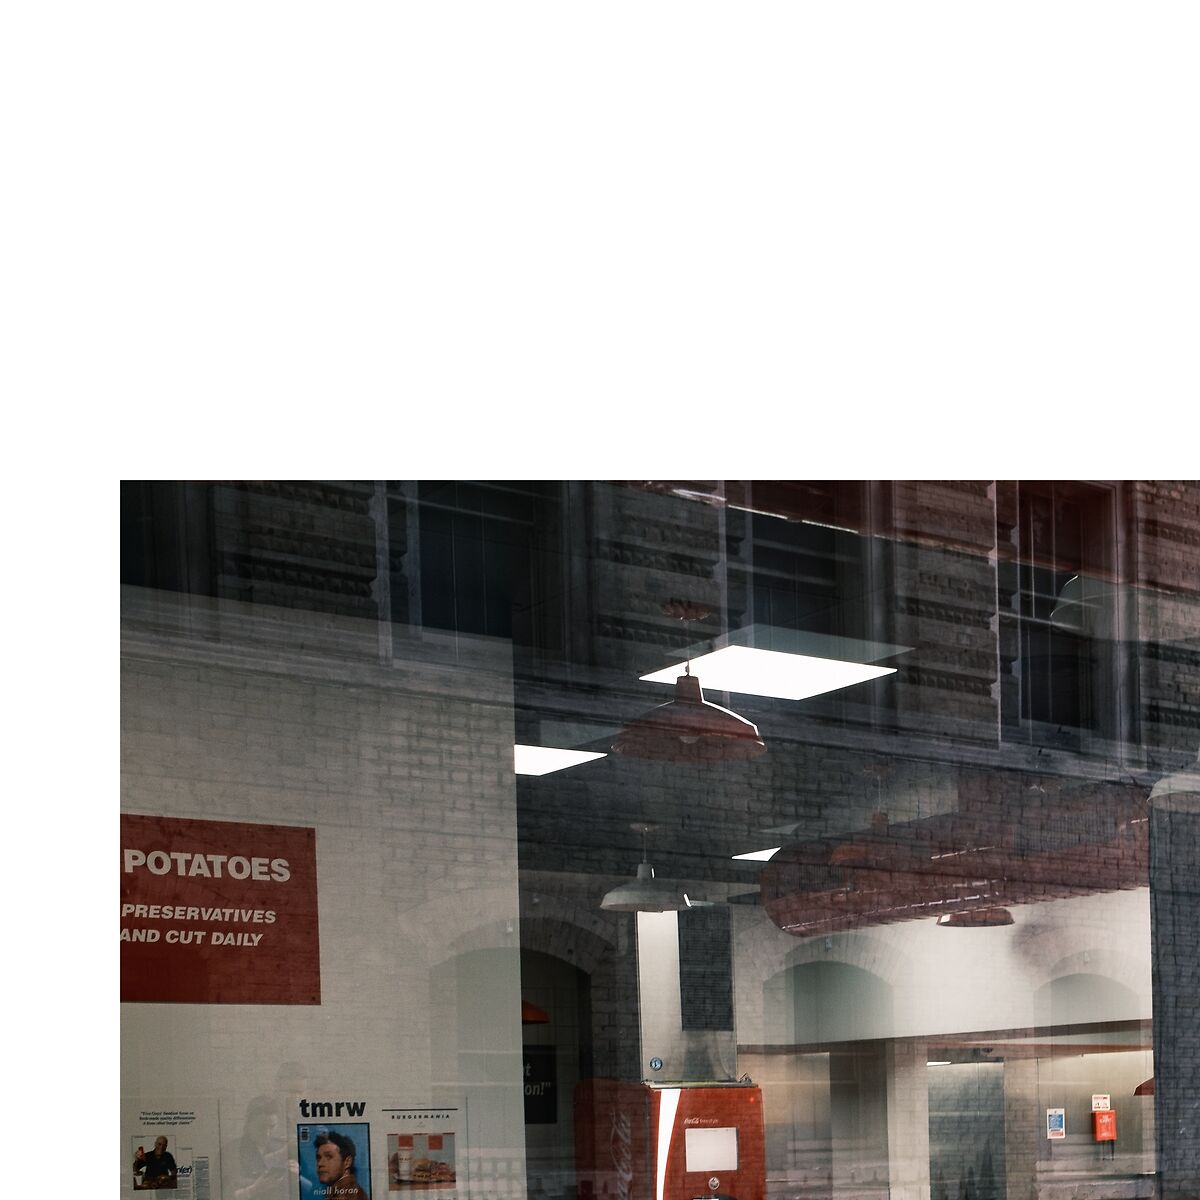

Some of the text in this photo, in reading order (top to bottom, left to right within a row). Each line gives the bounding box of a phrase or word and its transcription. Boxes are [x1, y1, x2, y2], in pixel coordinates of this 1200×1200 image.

[124, 849, 291, 883] POTATOES
[121, 903, 277, 925] PRESERVATIVES
[120, 929, 264, 947] AND CUT DAILY
[299, 1098, 368, 1119] tmrw
[391, 1113, 451, 1121] BURGERMANIA
[334, 1185, 359, 1195] horan
